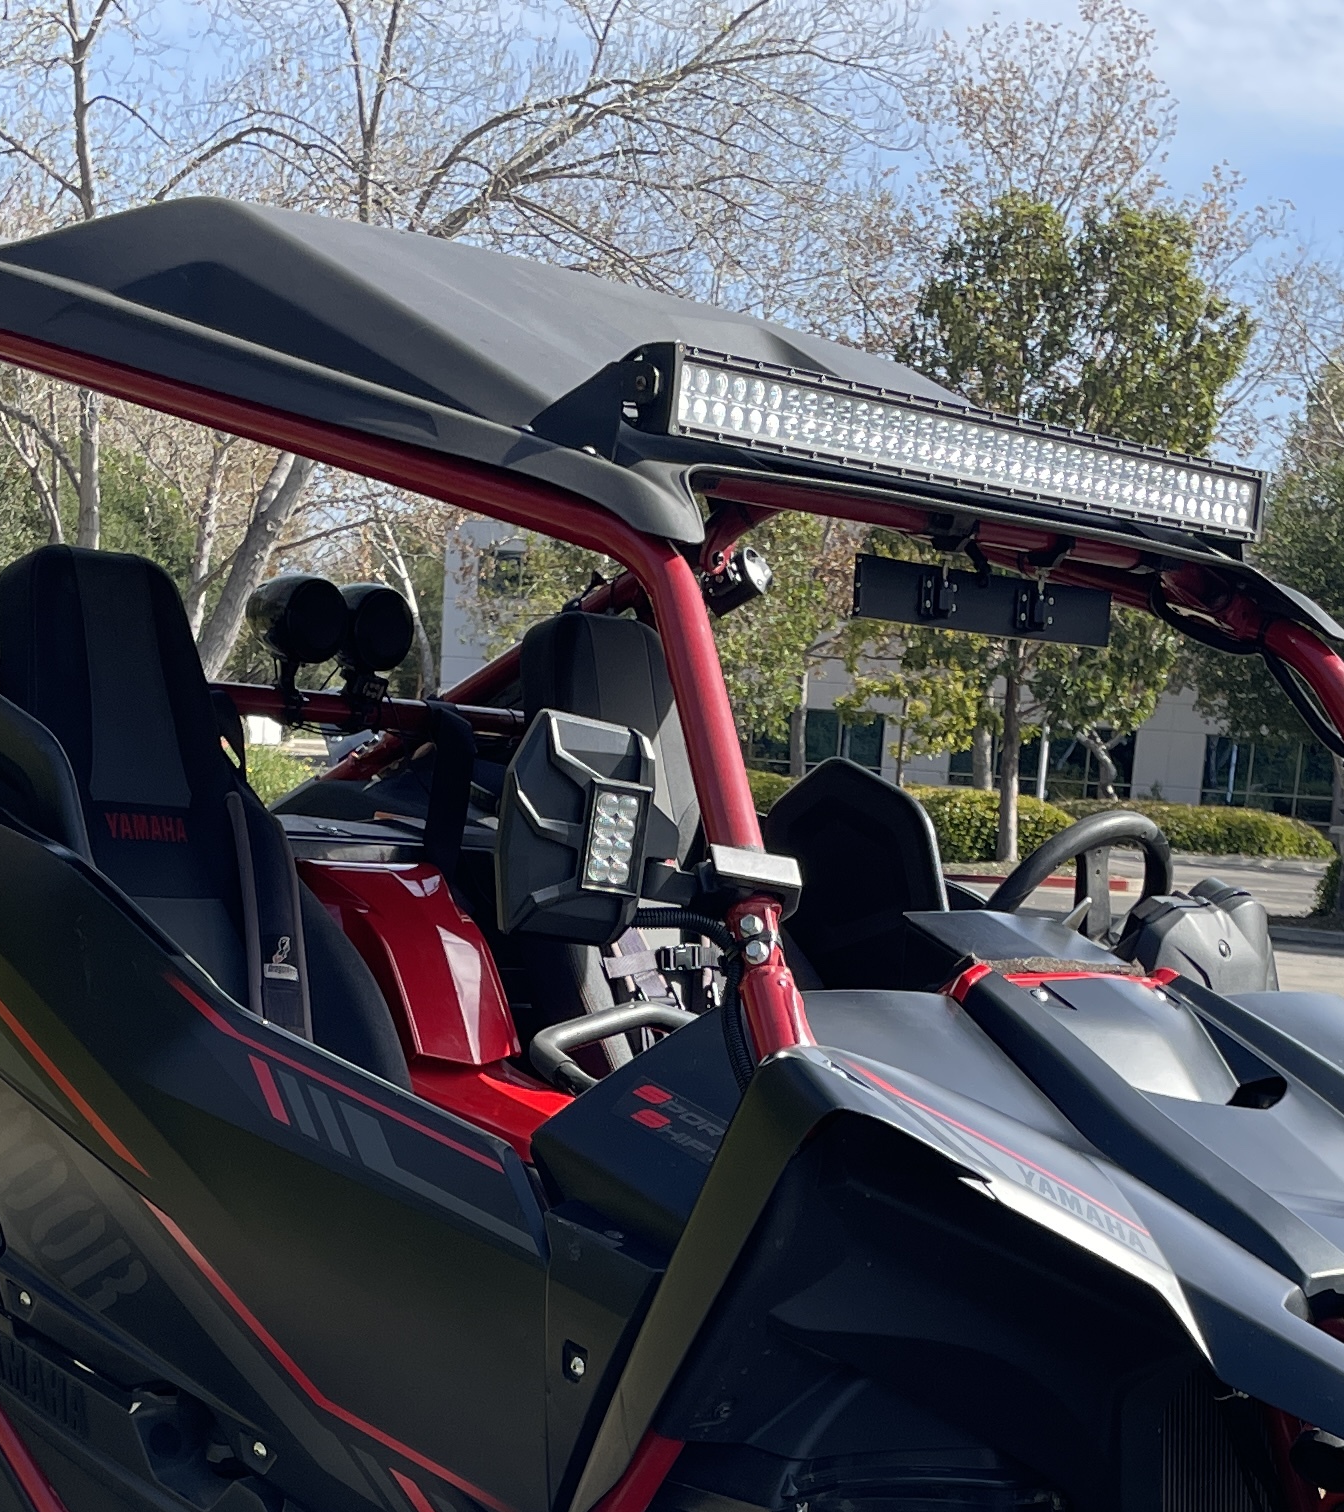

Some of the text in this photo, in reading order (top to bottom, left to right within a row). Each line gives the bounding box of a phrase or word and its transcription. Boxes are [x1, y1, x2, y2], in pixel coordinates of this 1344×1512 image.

[104, 812, 188, 842] YAMAHA
[632, 1084, 726, 1136] SPOR
[1016, 1163, 1147, 1254] YAMAHA
